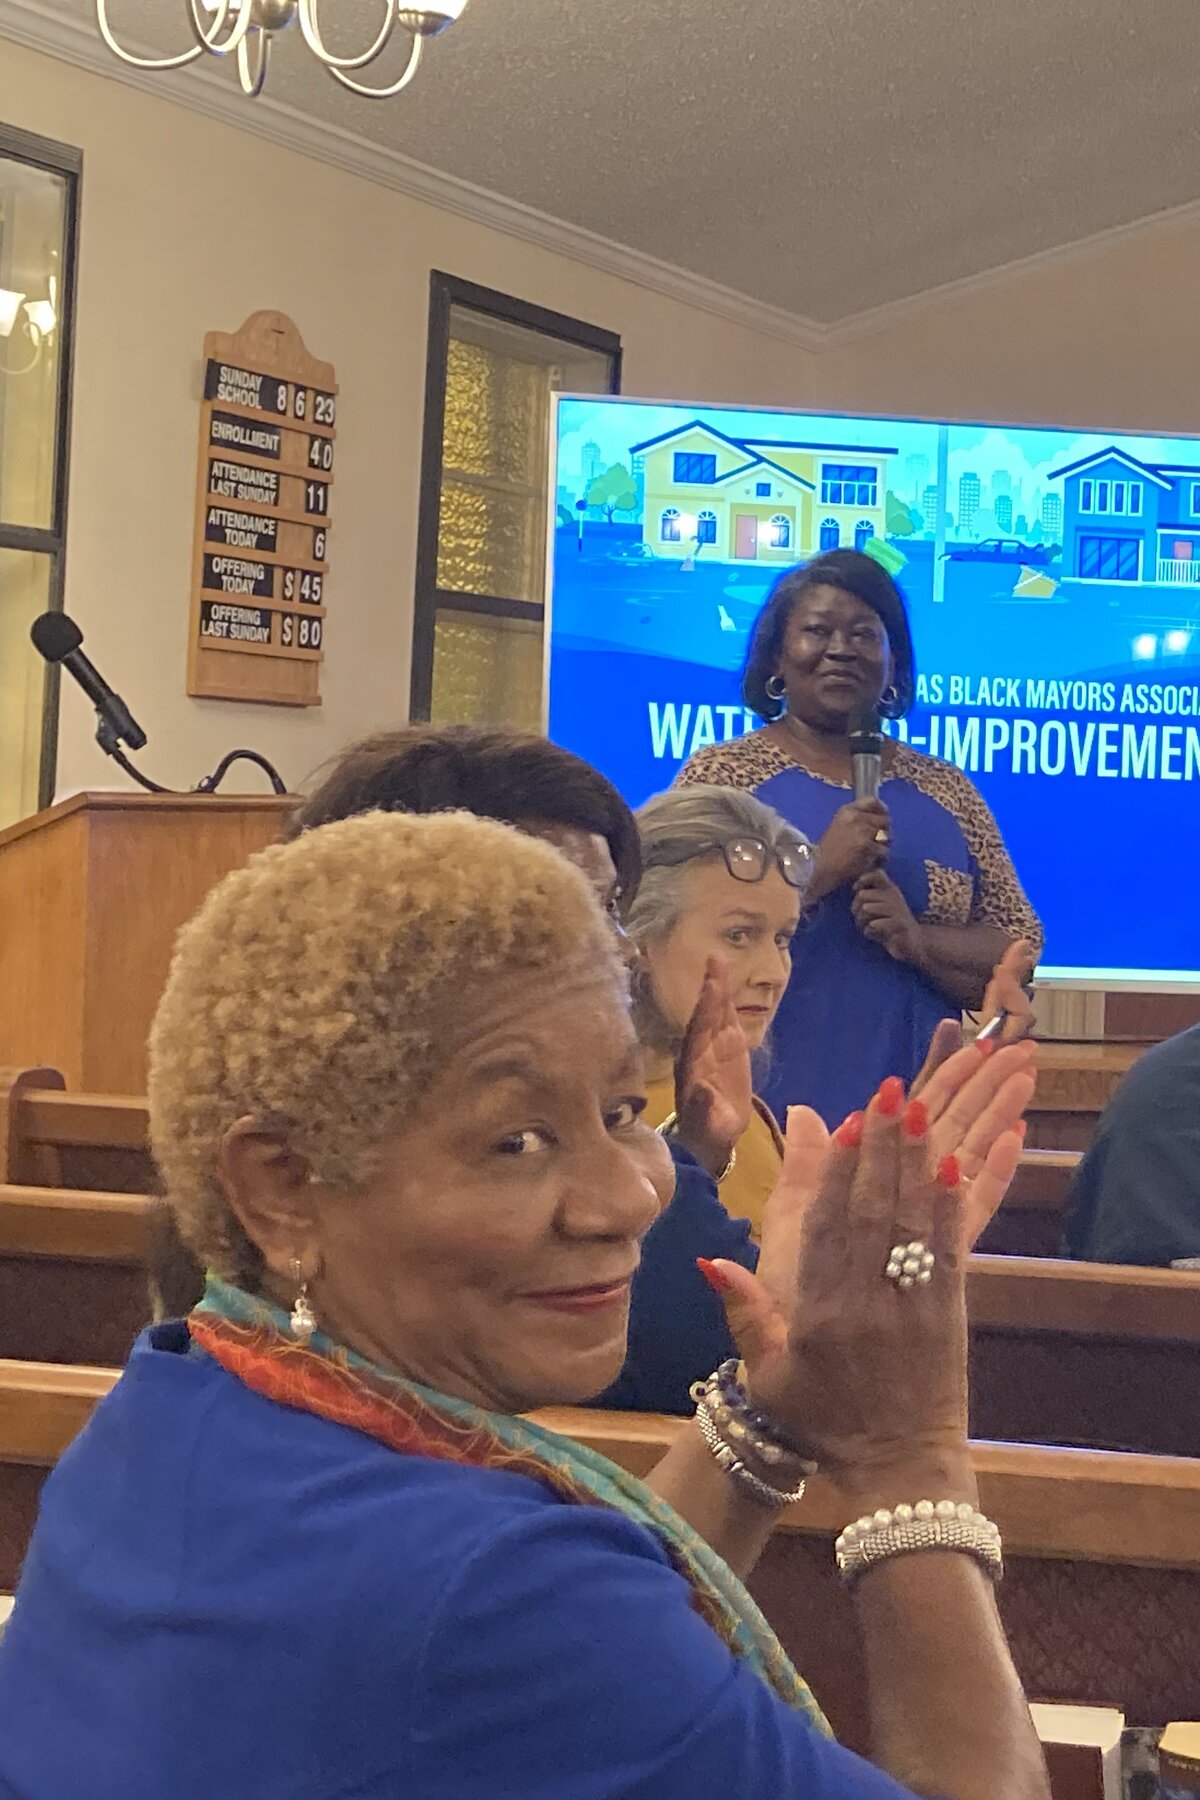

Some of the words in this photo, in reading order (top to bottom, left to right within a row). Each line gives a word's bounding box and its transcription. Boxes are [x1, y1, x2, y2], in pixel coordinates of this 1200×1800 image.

[219, 366, 263, 391] SUNDAY
[217, 384, 263, 409] SCHOOL
[276, 385, 287, 411] 8
[295, 391, 306, 416] 6
[314, 396, 335, 423] 23
[211, 421, 280, 451] ENROLLMENT
[310, 439, 332, 469] 40
[211, 461, 277, 488] ATTENDANCE
[210, 478, 237, 498] LAST
[237, 484, 277, 505] SUNDAY
[307, 484, 324, 512] 11
[208, 509, 276, 535] ATTENDANCE
[225, 528, 259, 549] TODAY
[315, 533, 325, 558] 6
[212, 557, 264, 580] OFFERING
[221, 575, 255, 595] TODAY
[211, 605, 261, 625] OFFERING
[202, 620, 227, 637] LAST
[229, 623, 270, 643] SUNDAY
[949, 675, 1021, 707] BLACK
[1026, 678, 1115, 713] MAYORS
